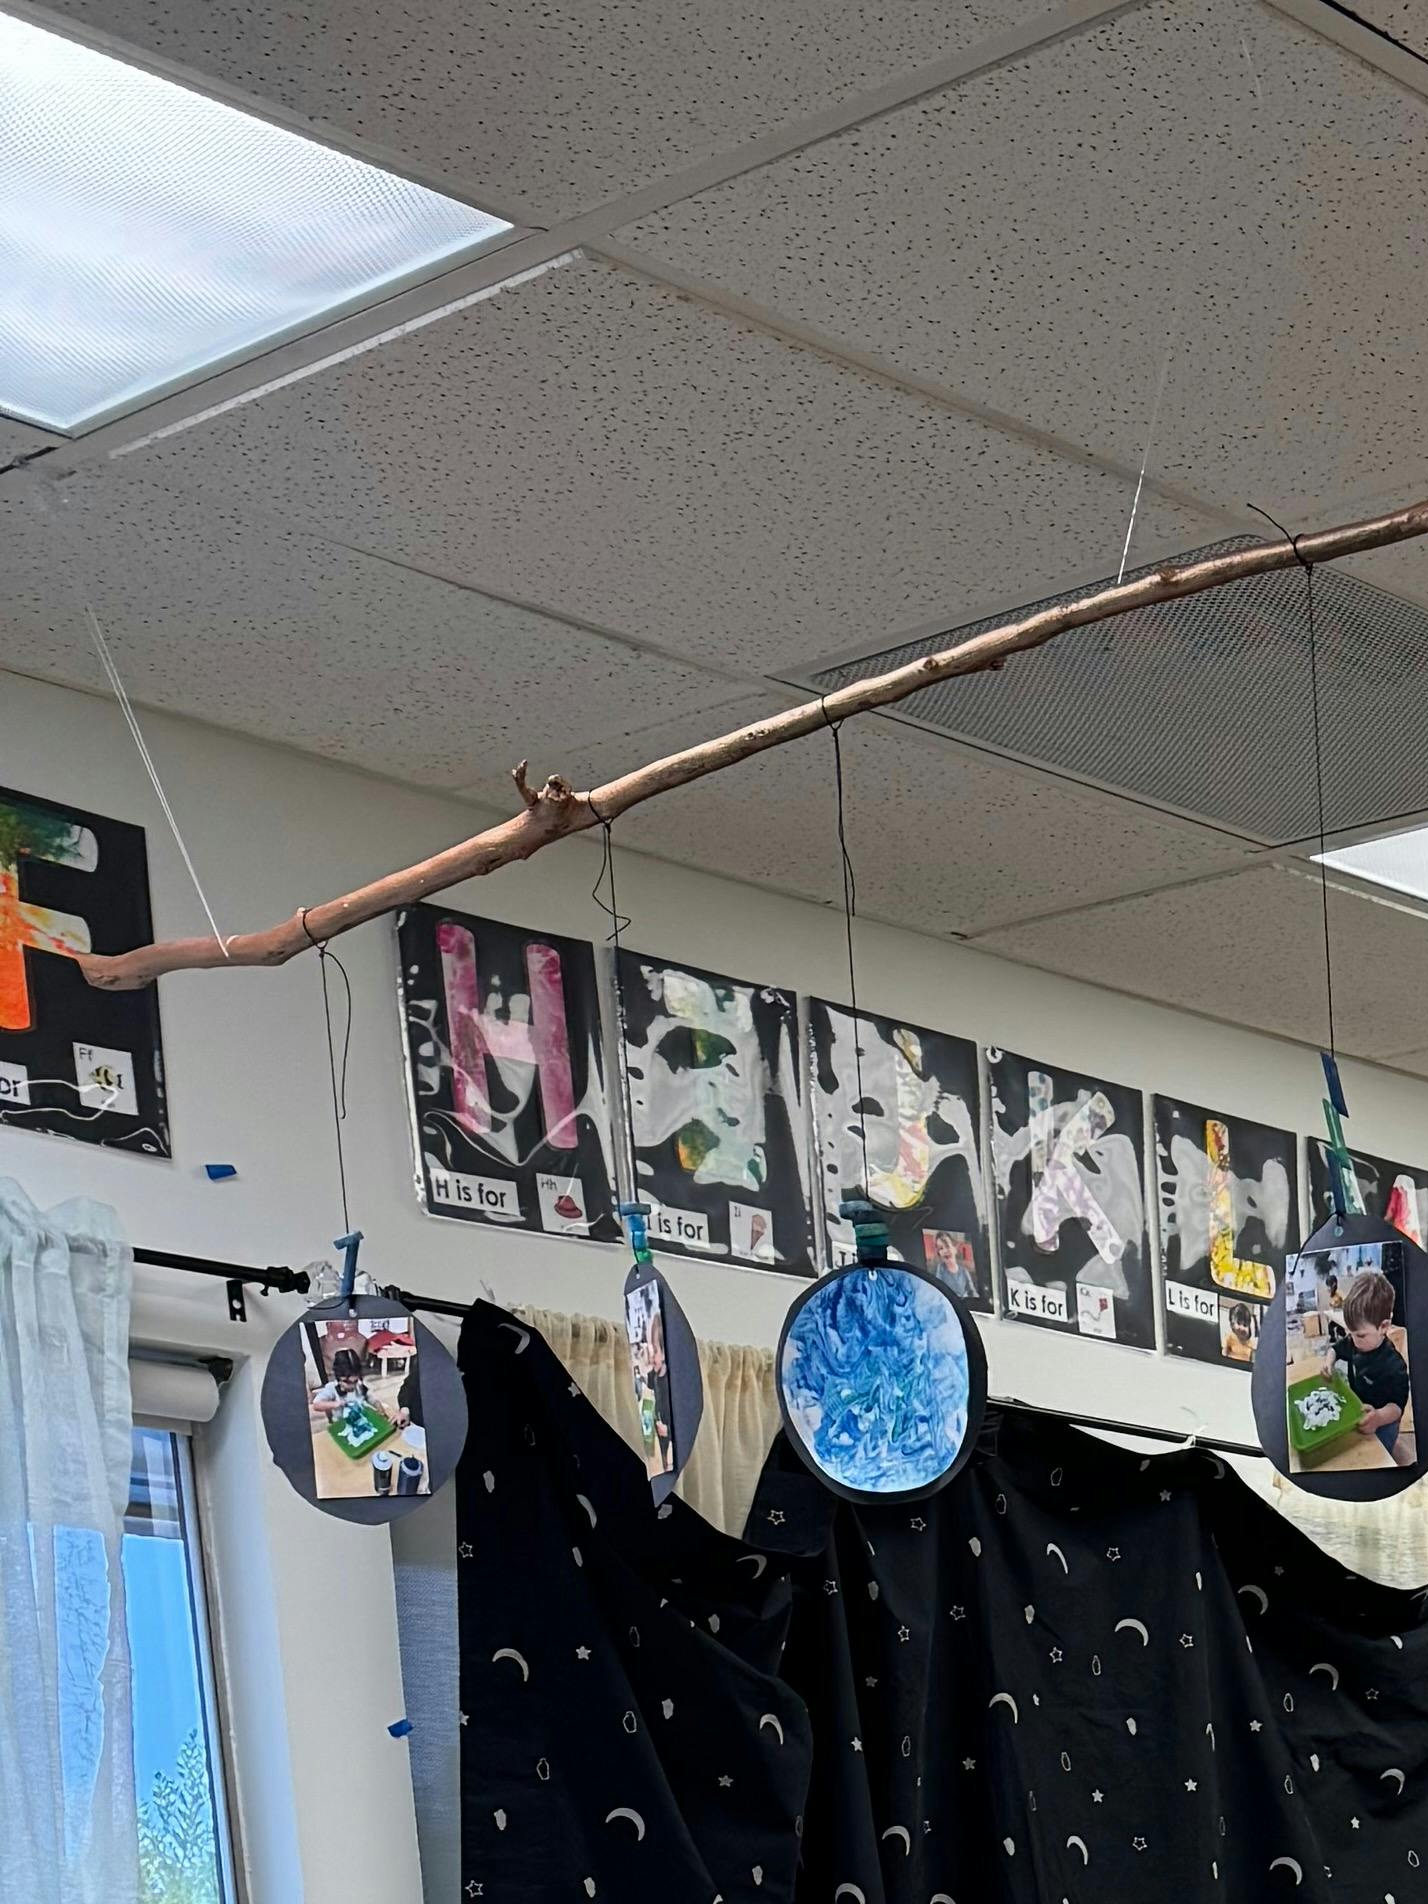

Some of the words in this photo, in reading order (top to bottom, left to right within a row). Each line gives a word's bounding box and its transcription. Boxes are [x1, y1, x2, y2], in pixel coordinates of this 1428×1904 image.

[437, 920, 577, 1149] H
[0, 1075, 21, 1097] or
[1027, 1070, 1125, 1265] K
[436, 1178, 450, 1200] H
[456, 1181, 474, 1203] is
[478, 1185, 507, 1208] for
[1205, 1119, 1277, 1300] L
[658, 1218, 672, 1236] is
[677, 1218, 704, 1241] for
[1010, 1286, 1021, 1309] K
[1024, 1290, 1039, 1313] is
[1041, 1291, 1065, 1317] for
[1167, 1287, 1175, 1308] L
[1177, 1290, 1191, 1312] is
[1192, 1290, 1215, 1318] for
